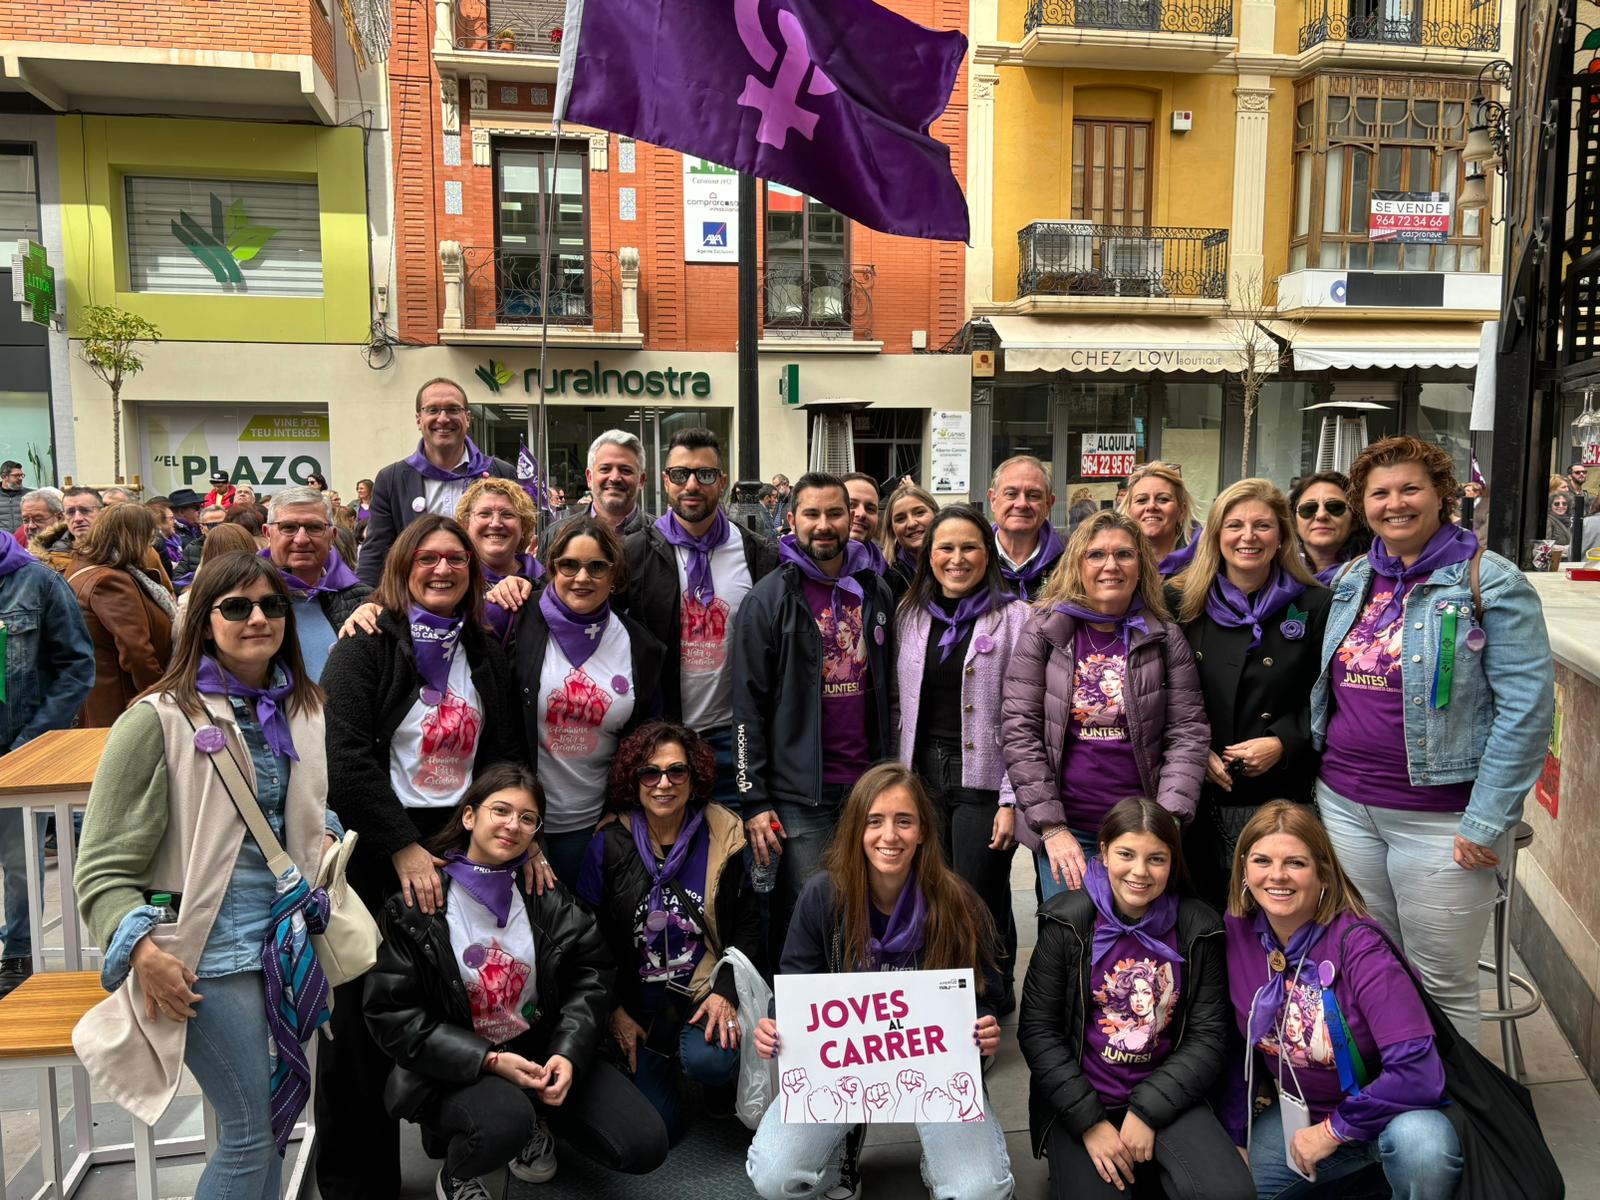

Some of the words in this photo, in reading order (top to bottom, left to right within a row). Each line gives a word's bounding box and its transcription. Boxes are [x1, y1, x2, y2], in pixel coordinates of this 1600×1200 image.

[1375, 201, 1393, 213] SE
[1396, 202, 1443, 214] VENDE
[1376, 214, 1395, 226] 964
[1397, 215, 1411, 227] 72
[1413, 216, 1427, 227] 34
[1429, 217, 1443, 228] 66
[1071, 351, 1121, 366] CHEZ
[1138, 351, 1180, 366] LOVI
[1180, 357, 1222, 366] BOUTIQUE
[523, 360, 711, 397] ruralnostra
[273, 418, 298, 427] VINE
[301, 418, 320, 427] PEL
[250, 428, 271, 438] TEU
[1097, 435, 1135, 451] ALQUILA
[1082, 455, 1098, 474] 964
[1099, 455, 1110, 474] 22
[1111, 455, 1123, 474] 95
[1344, 672, 1388, 687] JUNTES!
[806, 989, 909, 1033] JOVES
[888, 1018, 904, 1031] AL
[819, 1025, 948, 1069] CARRER
[1101, 1046, 1152, 1063] JUNTES!
